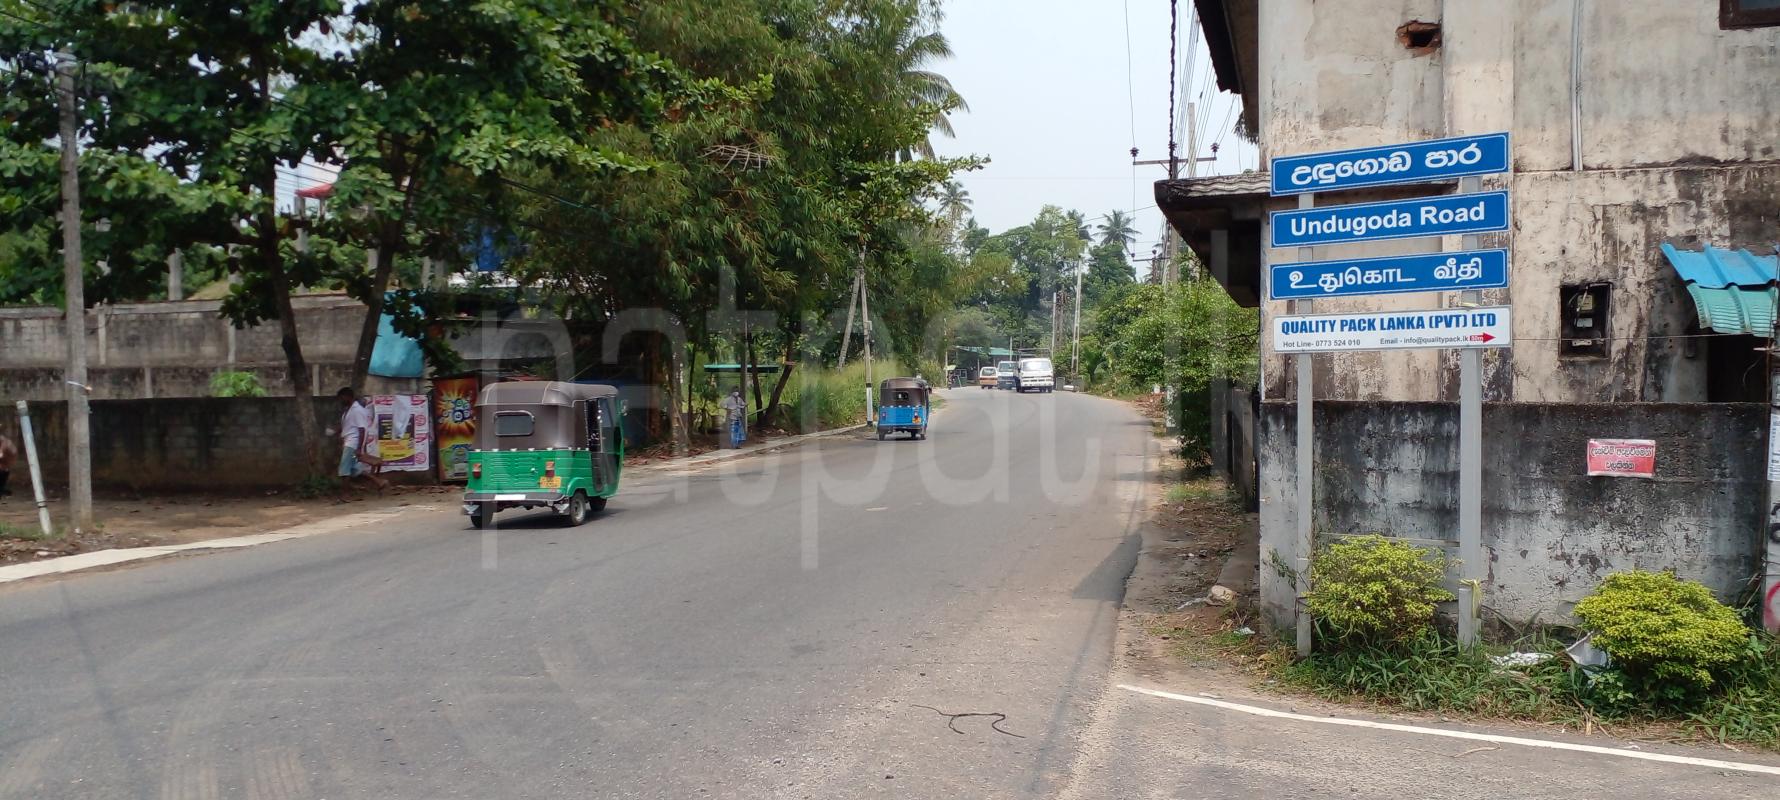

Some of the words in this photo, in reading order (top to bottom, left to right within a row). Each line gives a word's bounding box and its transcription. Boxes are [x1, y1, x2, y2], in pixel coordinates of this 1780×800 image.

[1290, 150, 1412, 185] උඳුගොඩ
[1425, 143, 1482, 168] පාර
[1290, 209, 1412, 236] Undugoda
[1420, 202, 1485, 226] Road
[1289, 266, 1416, 292] உதுகொட
[1434, 257, 1482, 283] வீதி
[1281, 319, 1337, 334] QUALITY
[1340, 318, 1377, 332] PACK
[1380, 316, 1426, 331] LANKA
[1428, 314, 1468, 329] (PVT)
[1471, 313, 1497, 327] LTD
[1315, 339, 1332, 347] 0773
[1380, 337, 1398, 345] Email
